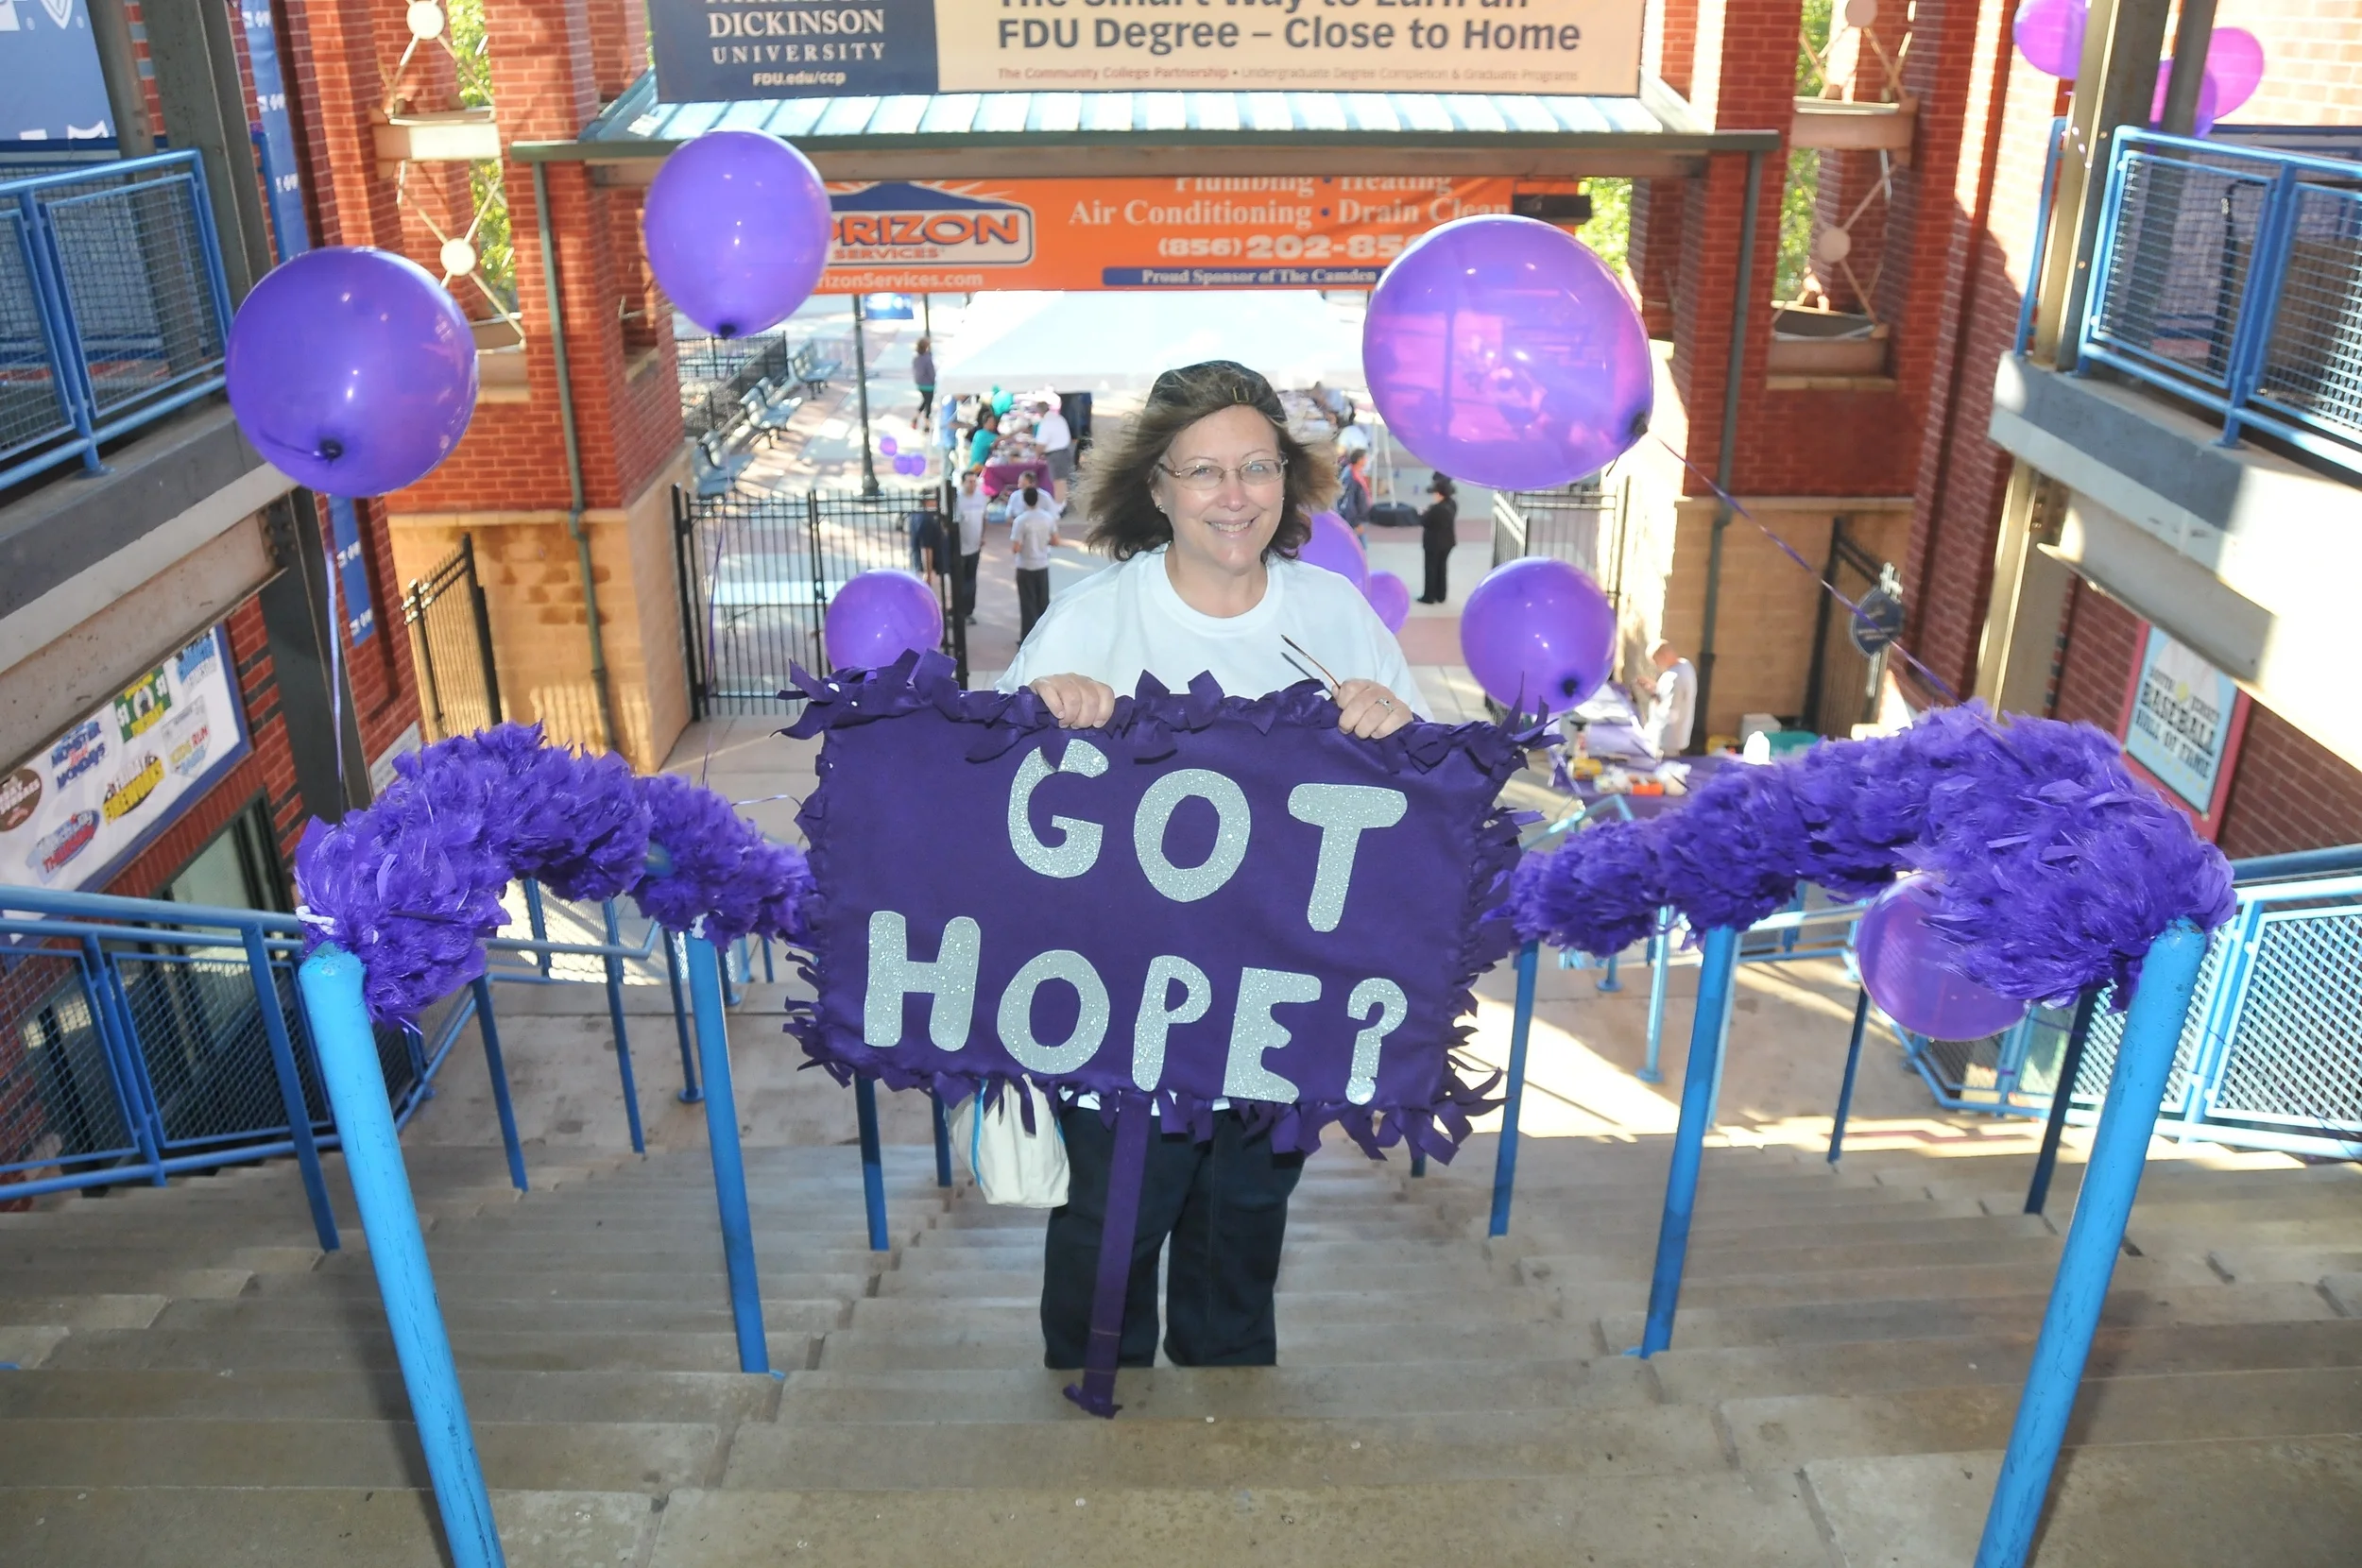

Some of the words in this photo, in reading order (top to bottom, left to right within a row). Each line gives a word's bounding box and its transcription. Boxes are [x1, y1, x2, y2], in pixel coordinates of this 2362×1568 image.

[708, 9, 885, 38] DICKINSON
[999, 19, 1078, 48] FDU
[1095, 18, 1240, 55] Degree
[1284, 16, 1395, 48] Close
[1409, 19, 1448, 48] to
[1464, 20, 1580, 50] Home
[711, 43, 885, 64] UNIVERSITY
[753, 71, 847, 86] FDU.edu/ccp
[998, 67, 1020, 79] The
[1025, 67, 1098, 81] Community
[1103, 67, 1150, 80] College
[1154, 66, 1227, 80] Partnership
[1069, 199, 1117, 226] Air
[1123, 199, 1312, 230] Conditioning
[1337, 198, 1420, 224] Drain
[831, 213, 1018, 246] RIZON
[833, 247, 939, 260] SERVICES
[1157, 236, 1242, 258] (856)
[1142, 269, 1190, 283] Proud
[1192, 269, 1257, 285] Sponsor
[1258, 269, 1276, 282] of
[1278, 269, 1309, 282] The
[1310, 268, 1377, 283] Camden
[1007, 739, 1408, 932] GOT
[864, 910, 1408, 1107] HOPE?
